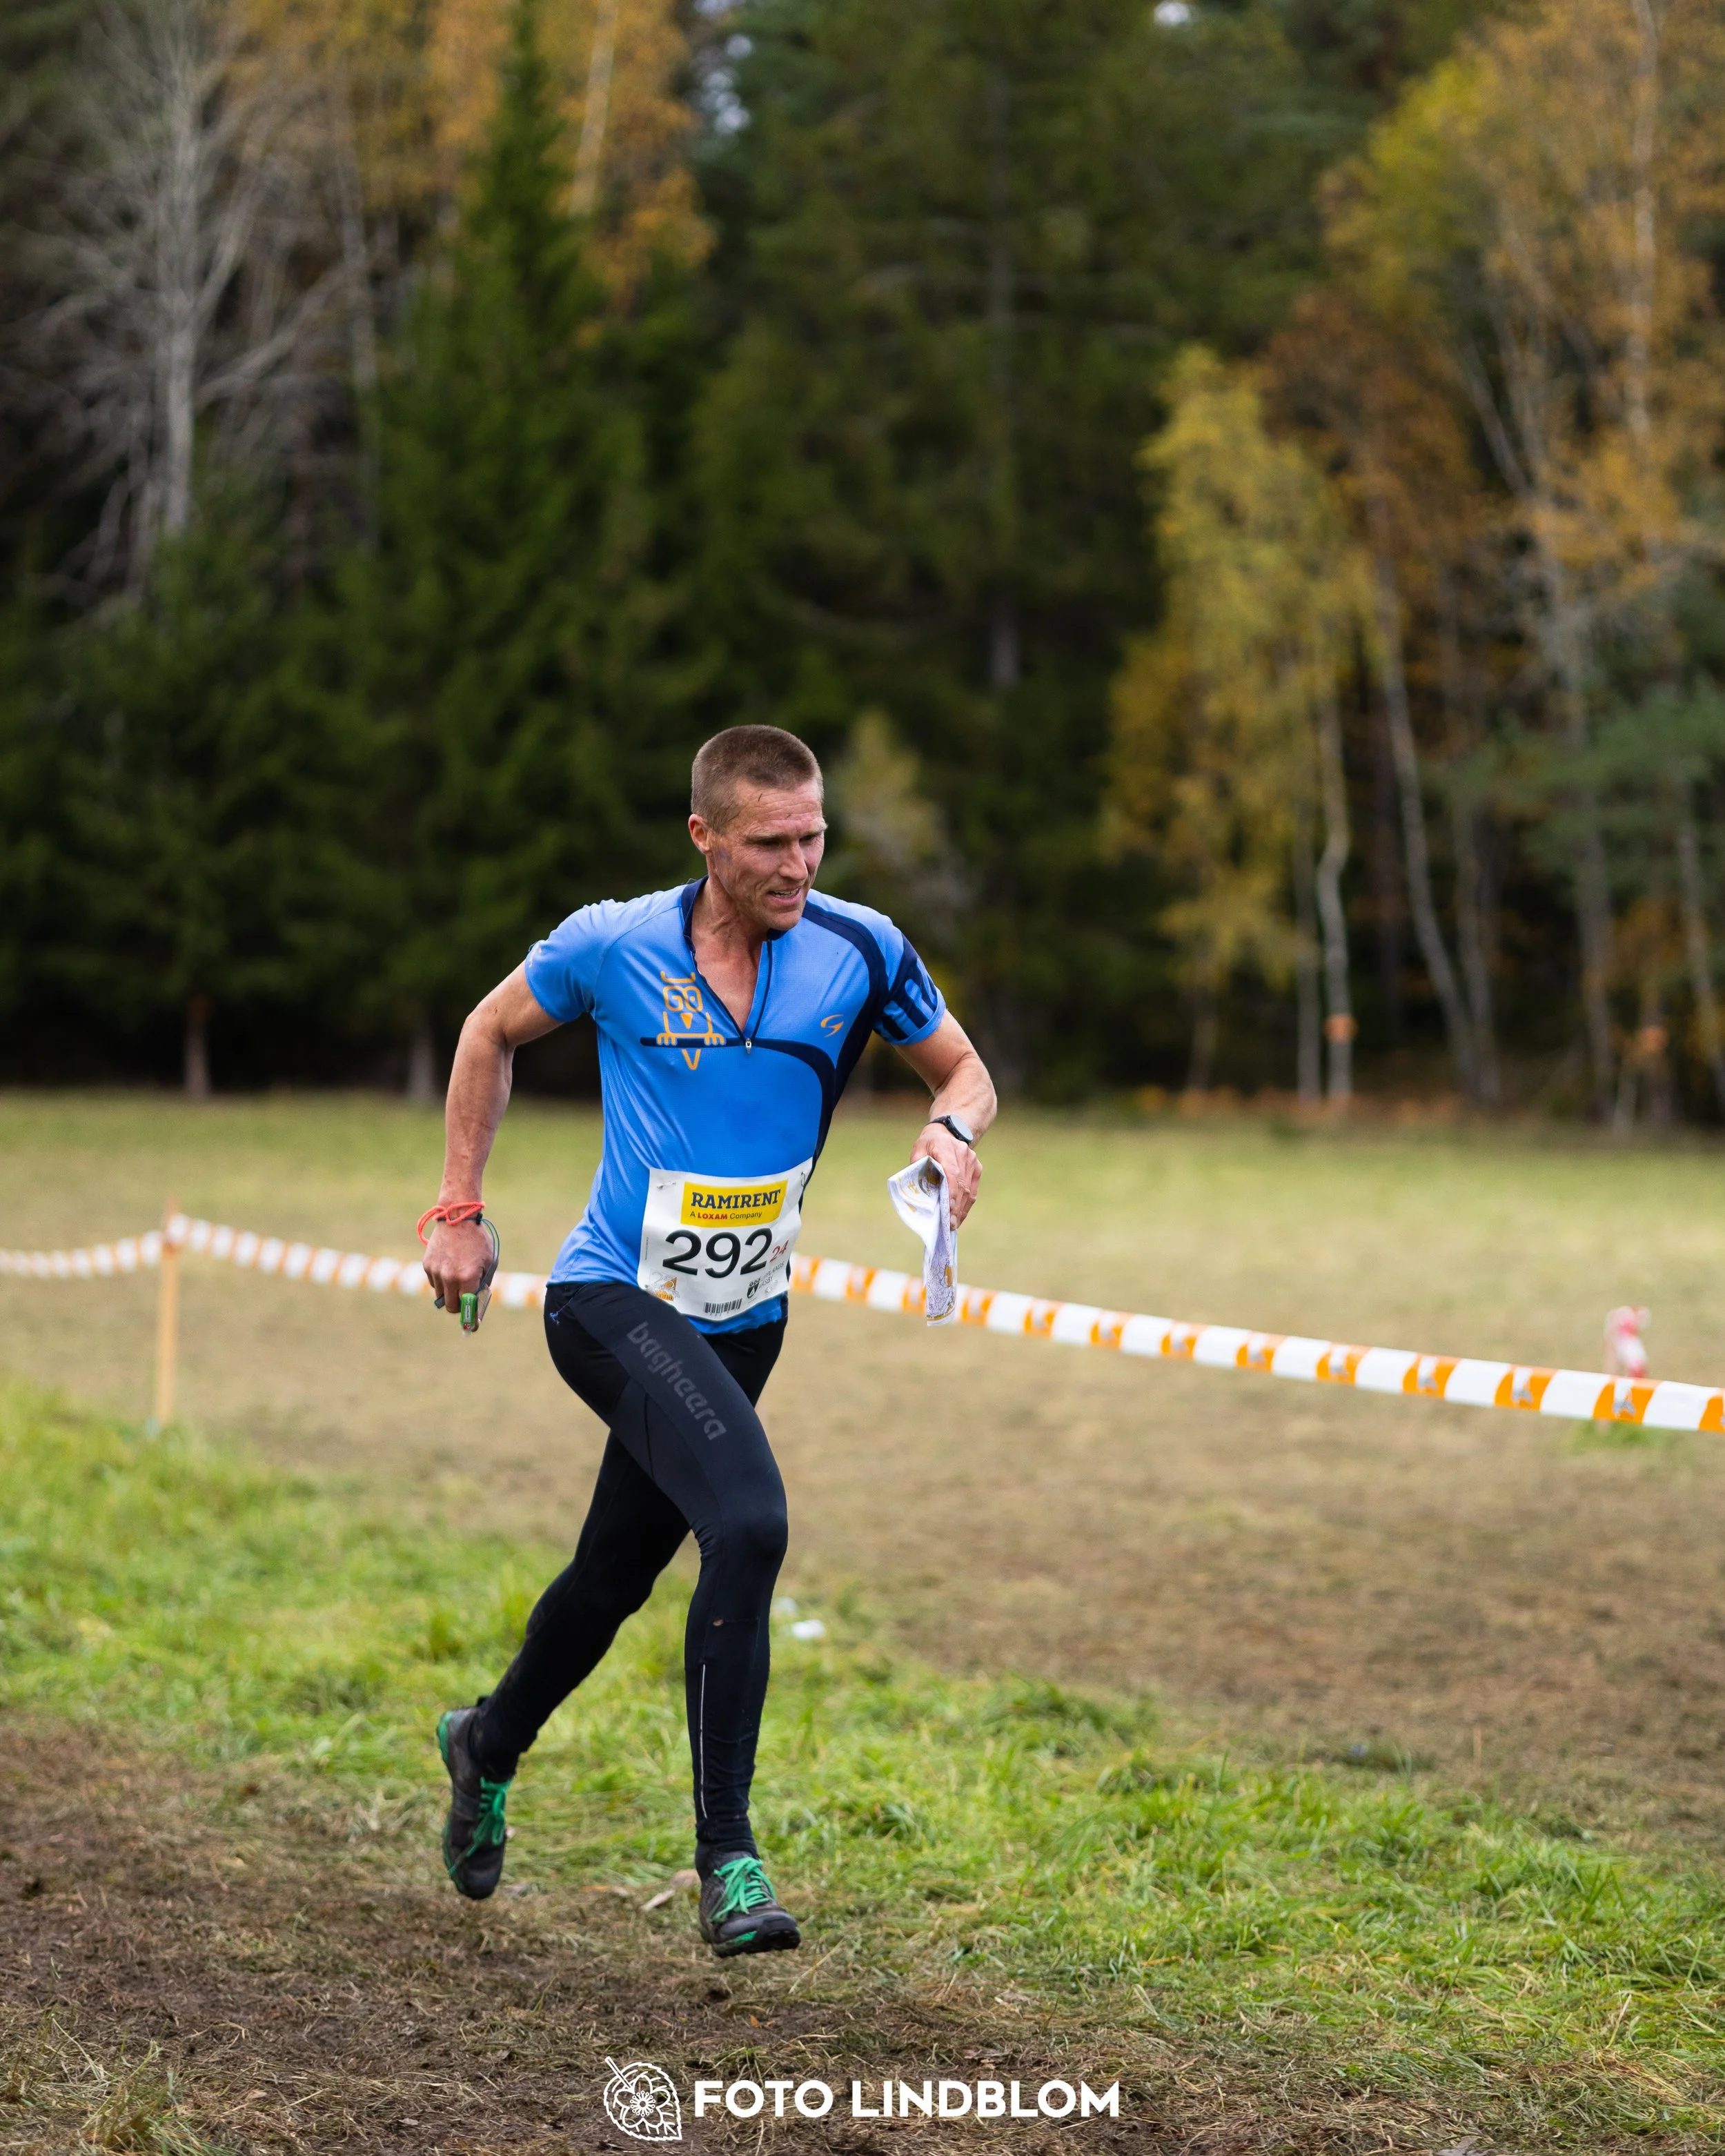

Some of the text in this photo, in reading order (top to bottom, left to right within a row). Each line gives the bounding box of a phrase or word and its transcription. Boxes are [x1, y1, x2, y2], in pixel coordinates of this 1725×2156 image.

[691, 1188, 781, 1209] RAMIRENT
[698, 1211, 728, 1220] LOXAM
[729, 1211, 762, 1220] Company
[662, 1227, 773, 1278] 292
[769, 1239, 789, 1263] 24
[627, 1321, 727, 1441] bagheera
